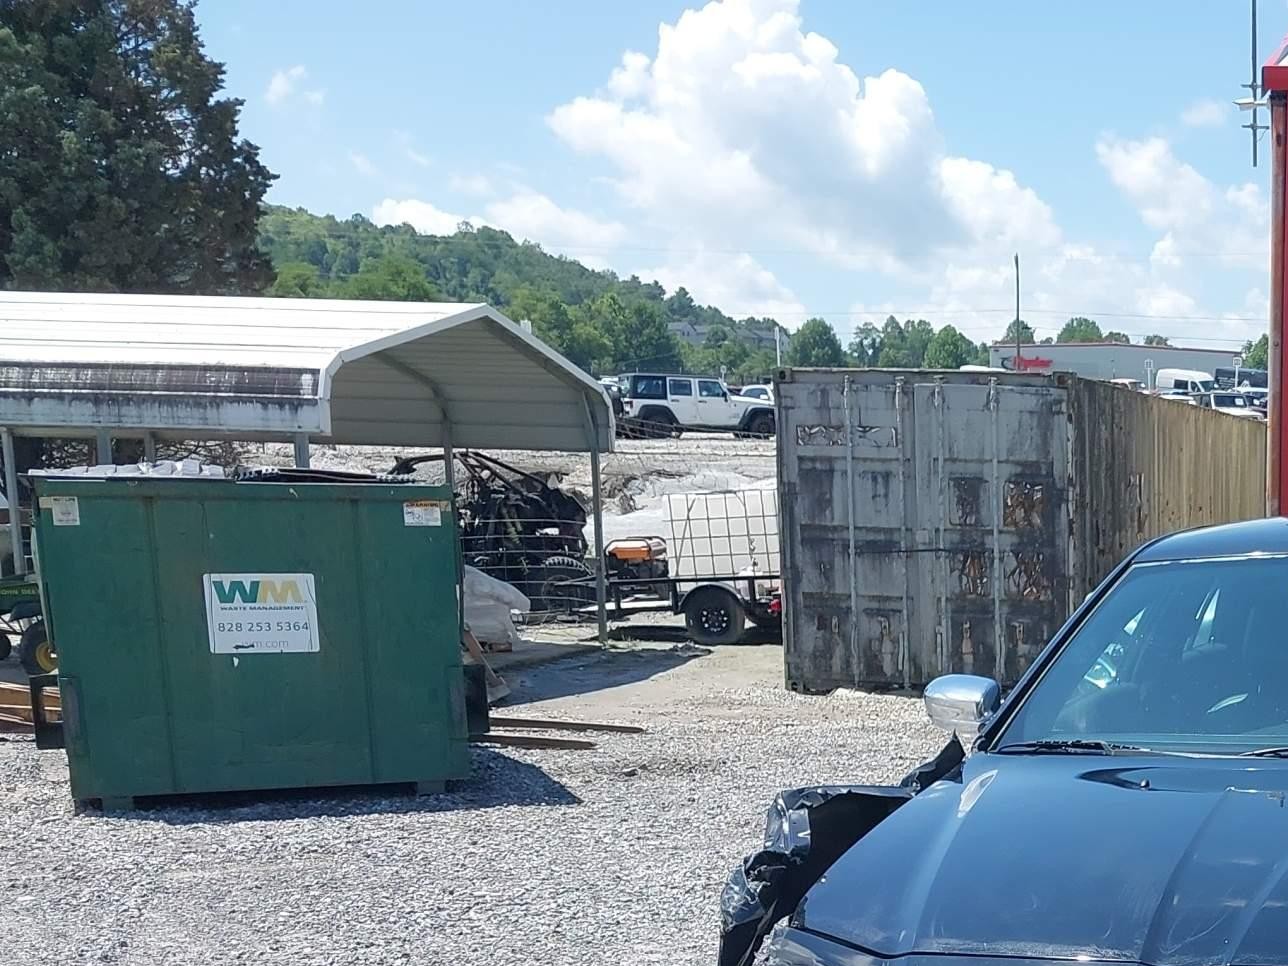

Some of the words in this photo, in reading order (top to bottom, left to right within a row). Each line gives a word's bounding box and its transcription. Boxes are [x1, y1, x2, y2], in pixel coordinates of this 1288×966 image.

[212, 580, 304, 604] WM
[218, 622, 243, 632] 828
[247, 622, 272, 632] 253
[276, 622, 309, 631] 5364
